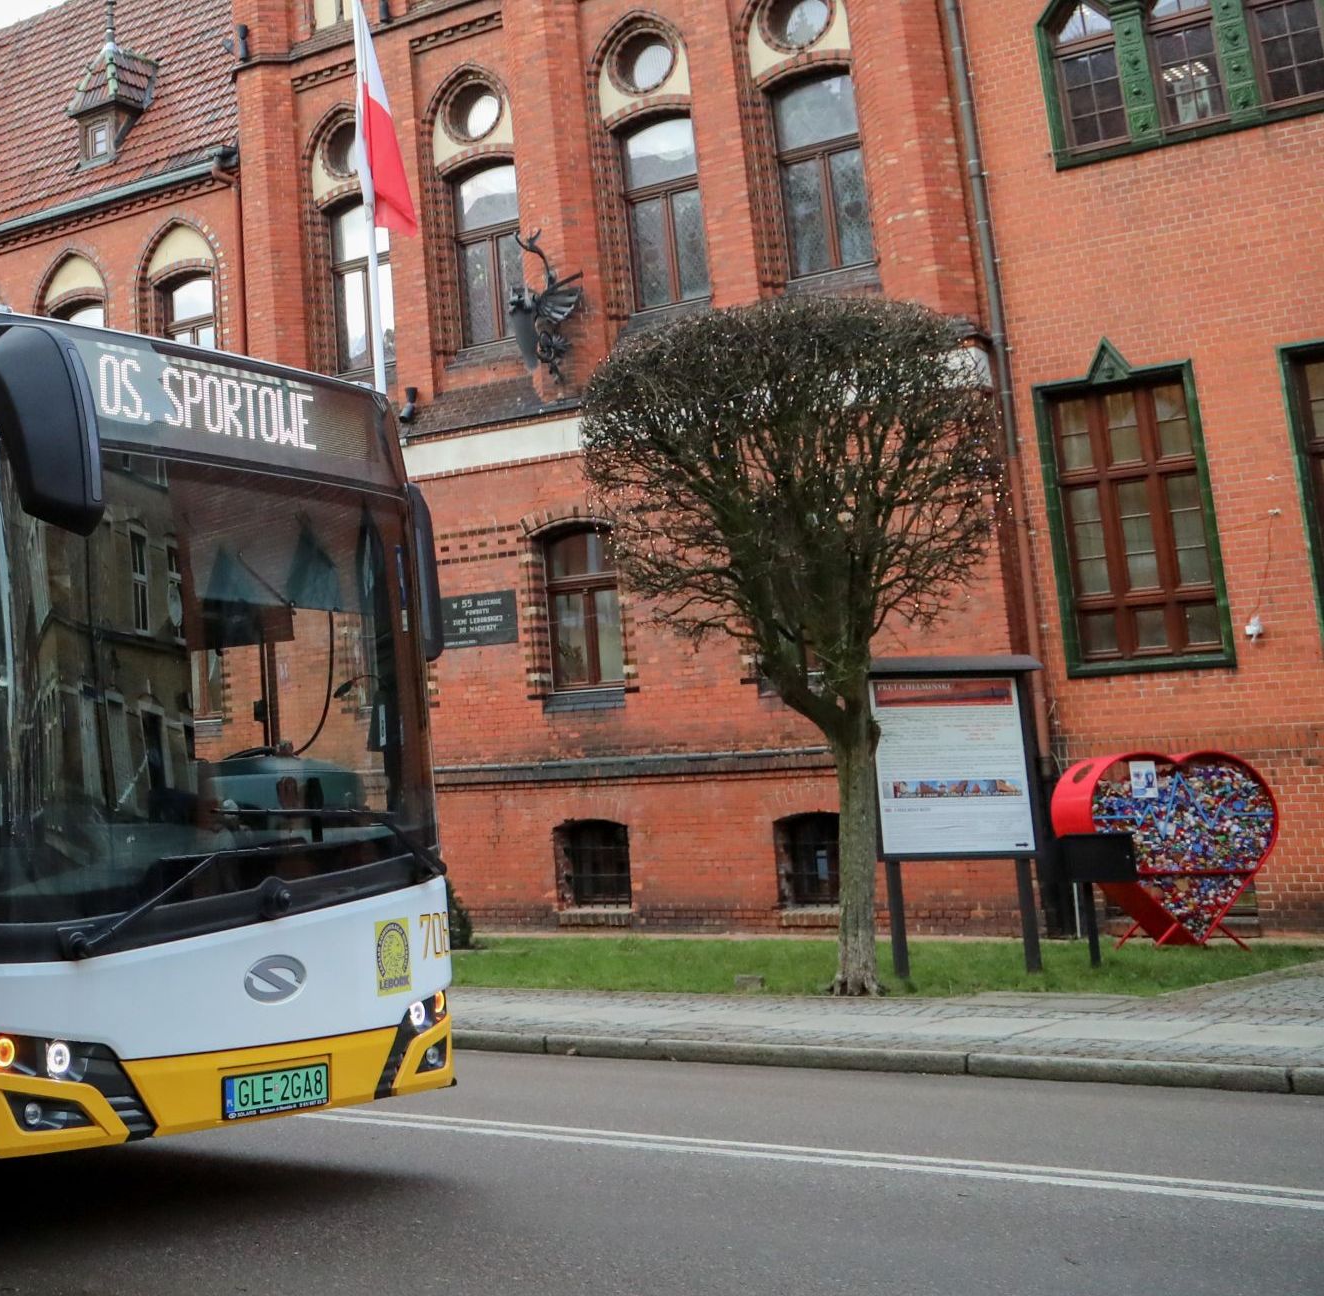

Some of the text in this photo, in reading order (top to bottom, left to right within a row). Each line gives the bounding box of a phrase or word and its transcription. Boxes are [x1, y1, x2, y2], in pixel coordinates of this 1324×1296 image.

[99, 353, 316, 450] OS. SPORTOWE
[461, 599, 473, 608] 55
[238, 1069, 323, 1107] GLE 2GA8
